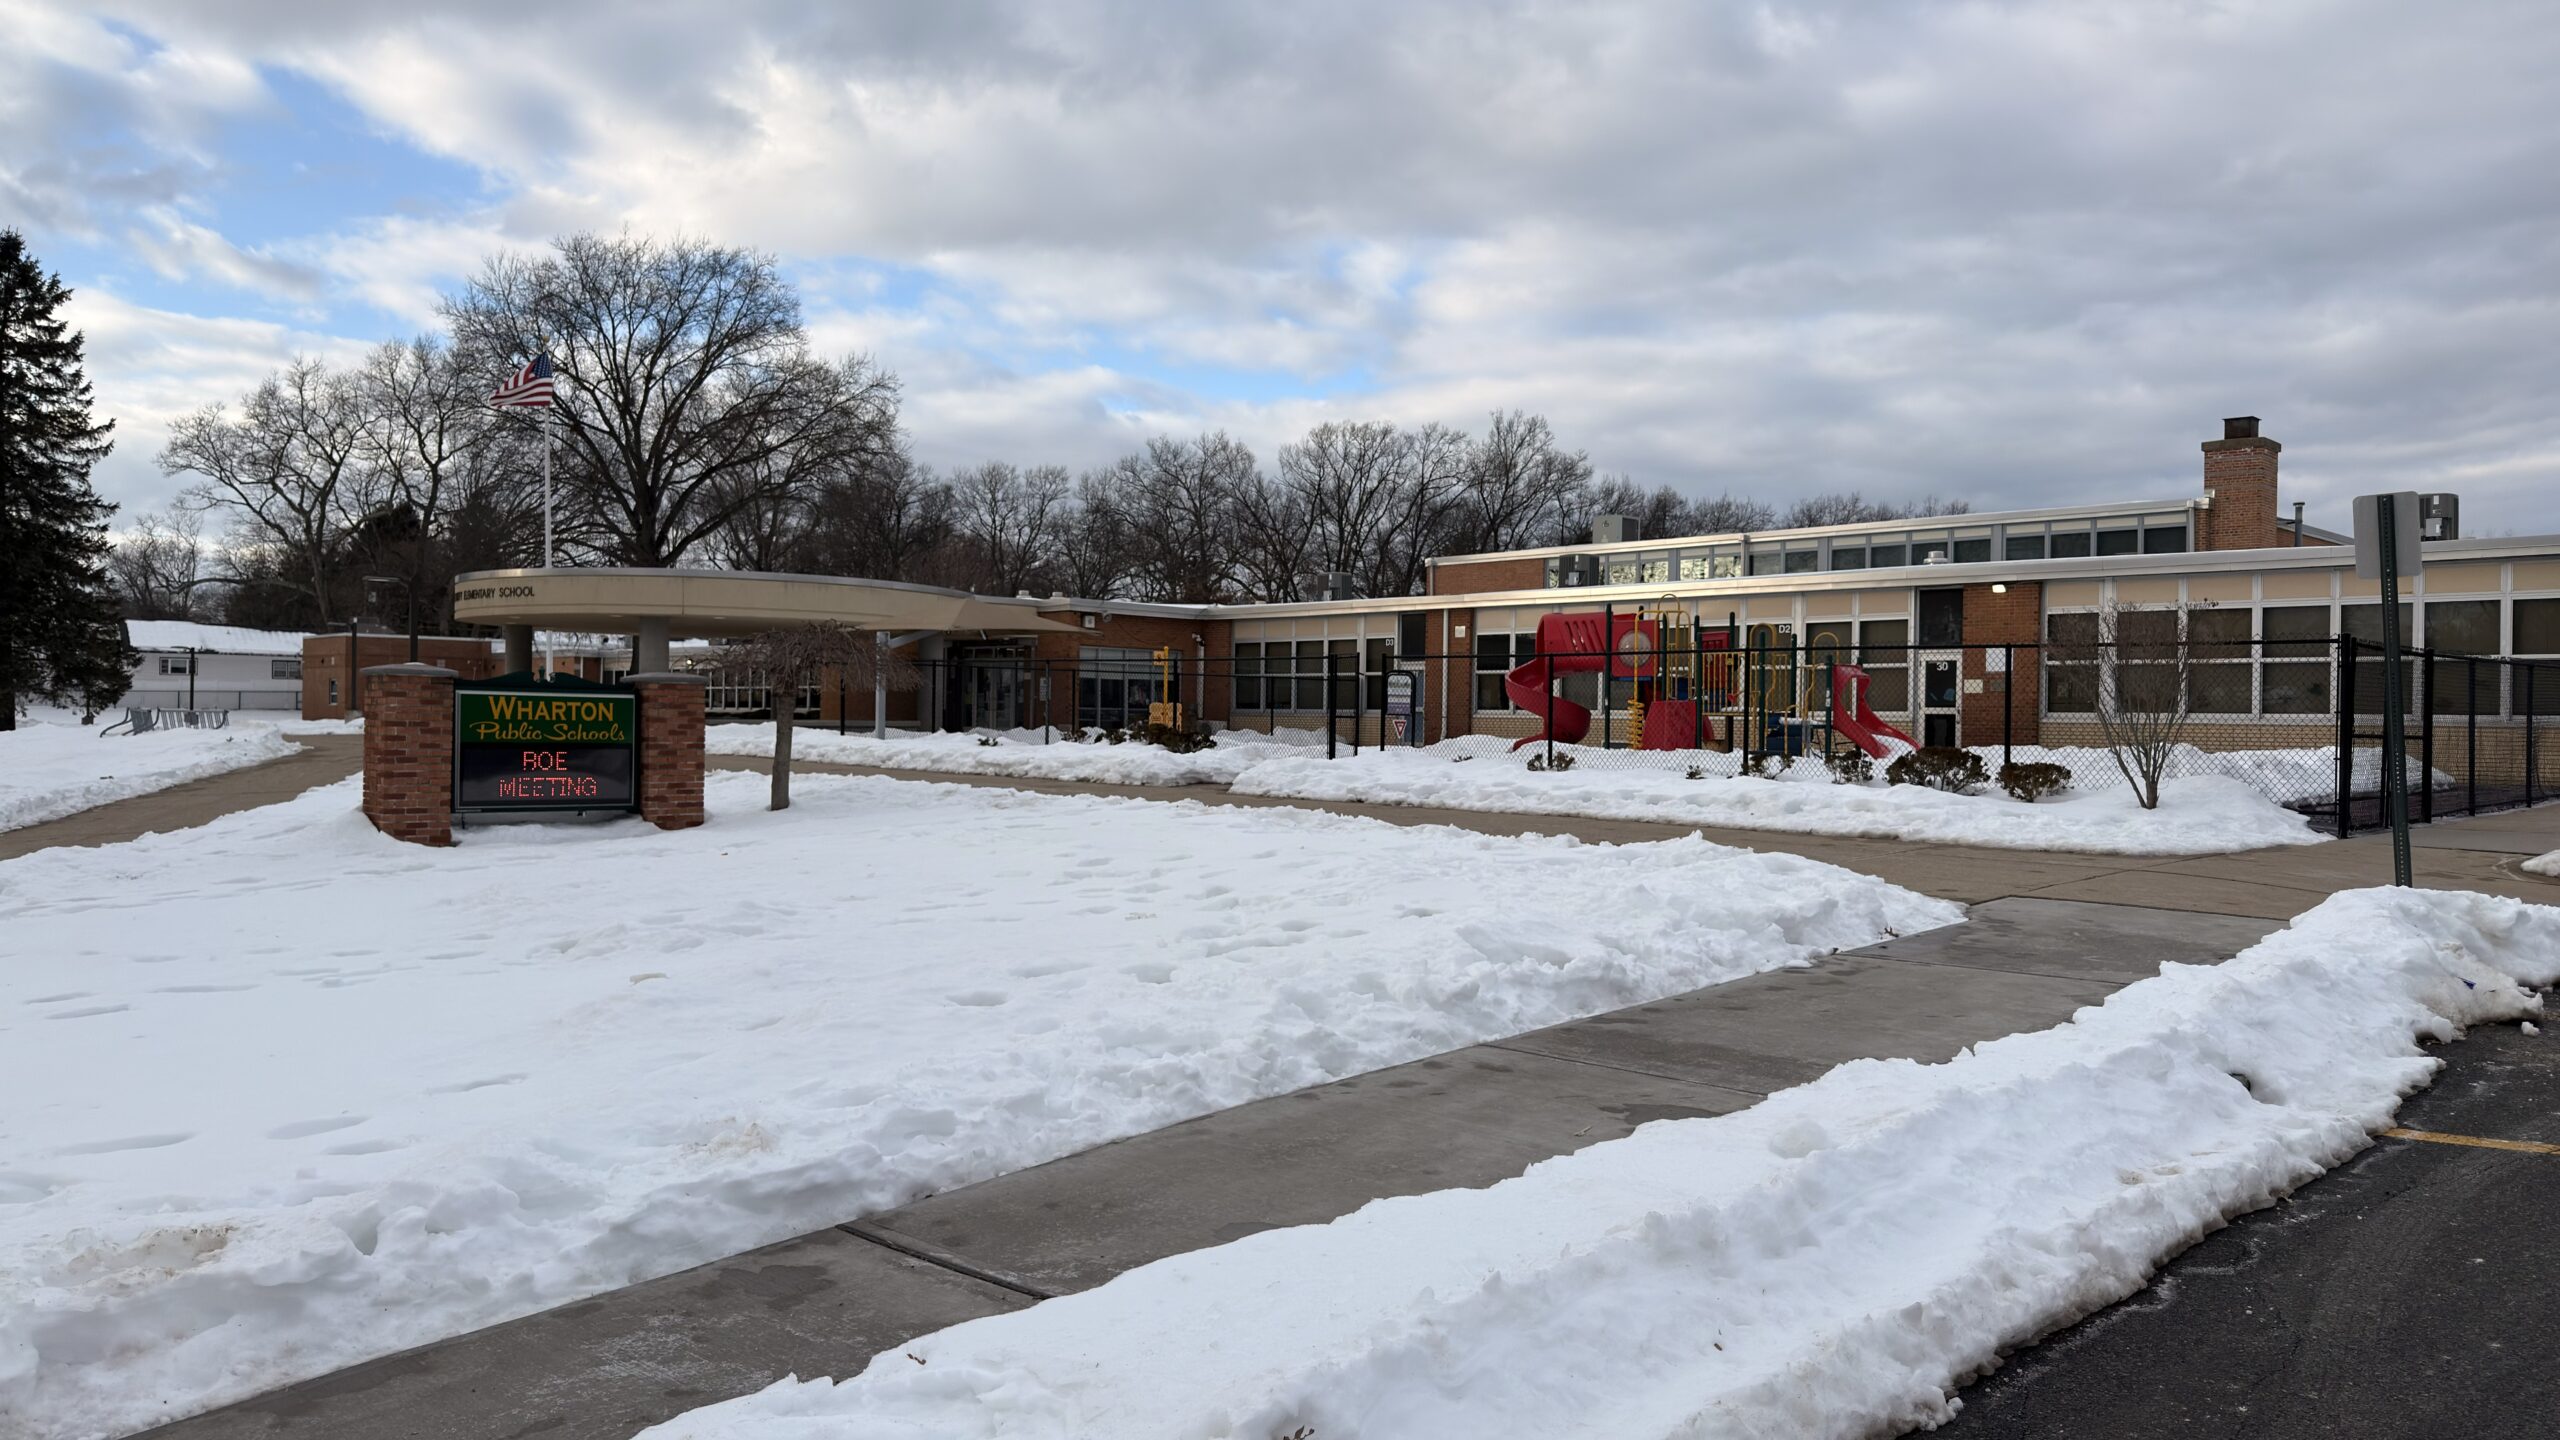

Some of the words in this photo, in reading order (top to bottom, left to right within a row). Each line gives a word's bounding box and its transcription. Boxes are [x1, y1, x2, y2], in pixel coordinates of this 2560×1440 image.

[499, 586, 535, 598] SCHOOL
[1936, 661, 1949, 671] 30
[470, 721, 541, 740] Public
[544, 722, 625, 741] Schools
[500, 777, 597, 797] MEETING
